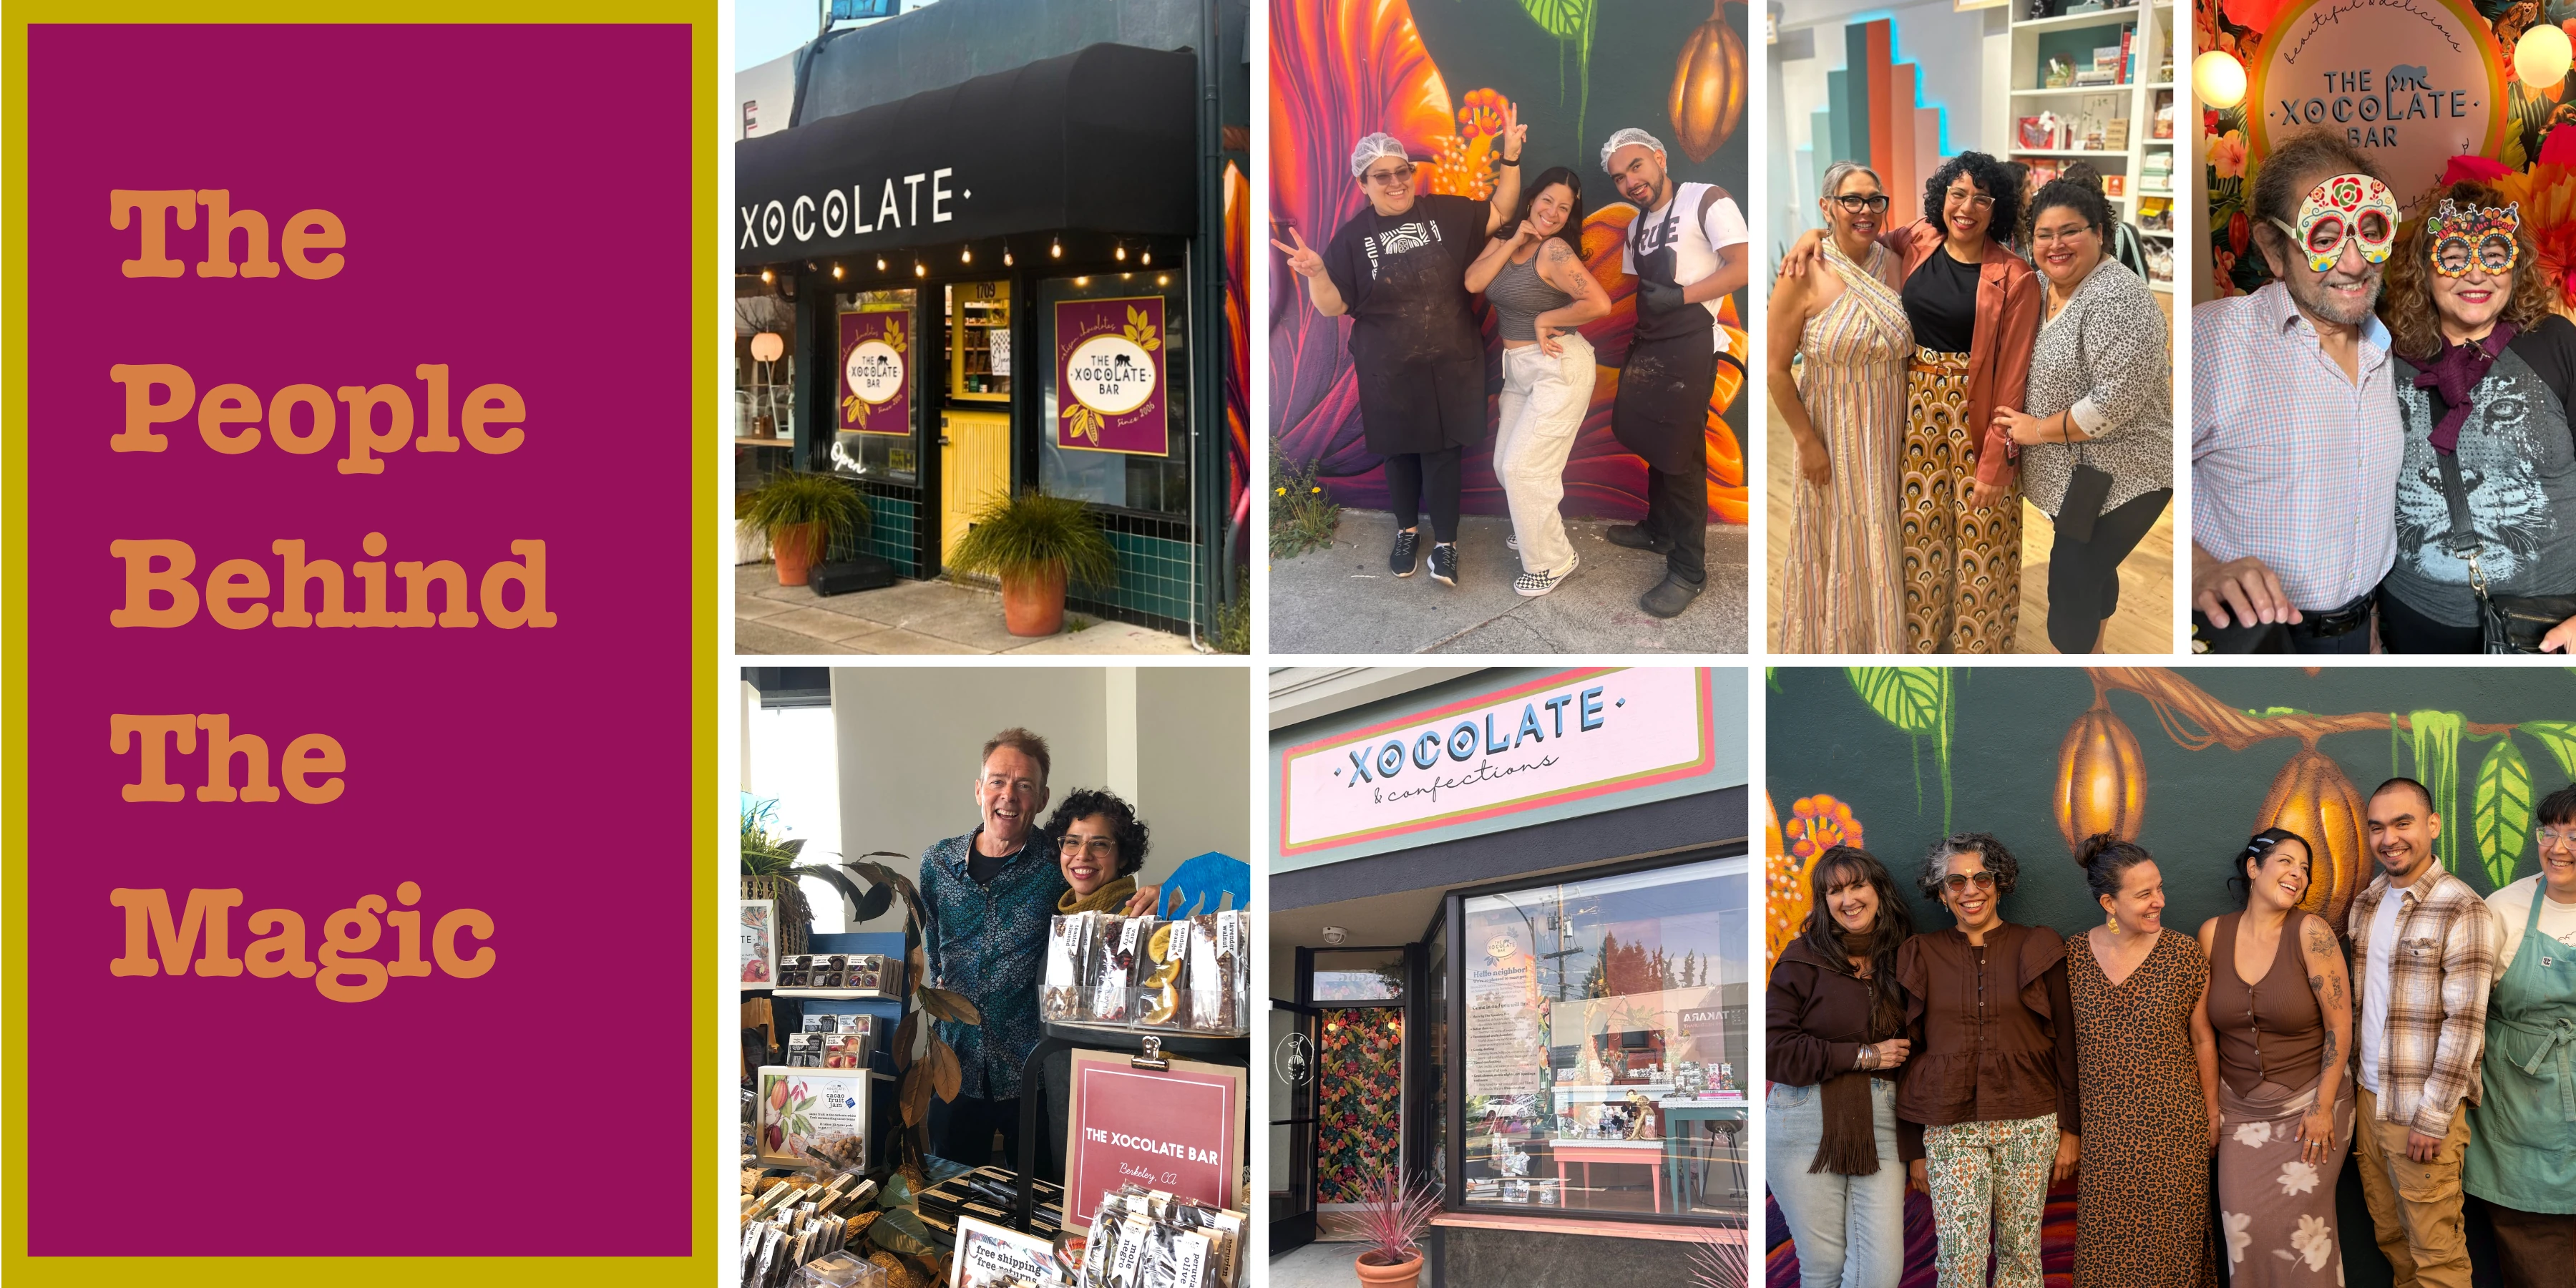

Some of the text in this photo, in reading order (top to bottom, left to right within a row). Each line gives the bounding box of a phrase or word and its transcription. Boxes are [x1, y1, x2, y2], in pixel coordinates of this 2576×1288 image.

[2323, 69, 2373, 94] THE
[2281, 76, 2467, 126] XOCOLATE
[2347, 125, 2398, 148] BAR
[740, 167, 952, 250] XOCOLATE
[2437, 223, 2459, 240] Day
[2474, 220, 2489, 232] the
[2491, 218, 2516, 232] dead
[976, 283, 995, 298] 1709
[852, 361, 898, 378] XOCOLATE
[862, 356, 874, 365] THE
[1075, 361, 1146, 382] XOCOLATE
[1091, 355, 1110, 366] THE
[867, 379, 881, 388] BAR
[1099, 384, 1120, 395] BAR
[1117, 401, 1156, 427] Since 2006
[831, 441, 867, 474] Open
[1347, 686, 1605, 788] XOCOLATE
[1374, 753, 1560, 804] & confections
[1123, 927, 1132, 946] berry
[1473, 965, 1528, 978] Hello neighbor!
[1523, 1096, 1536, 1105] MADE
[1086, 1127, 1218, 1166] THE XOCOLATE BAR
[1119, 1162, 1177, 1185] Berkeley, CA
[976, 1245, 1042, 1277] free shipping
[977, 1257, 996, 1271] free
[1118, 1239, 1130, 1269] negro
[1126, 1244, 1137, 1269] mole
[1180, 1257, 1190, 1284] olive
